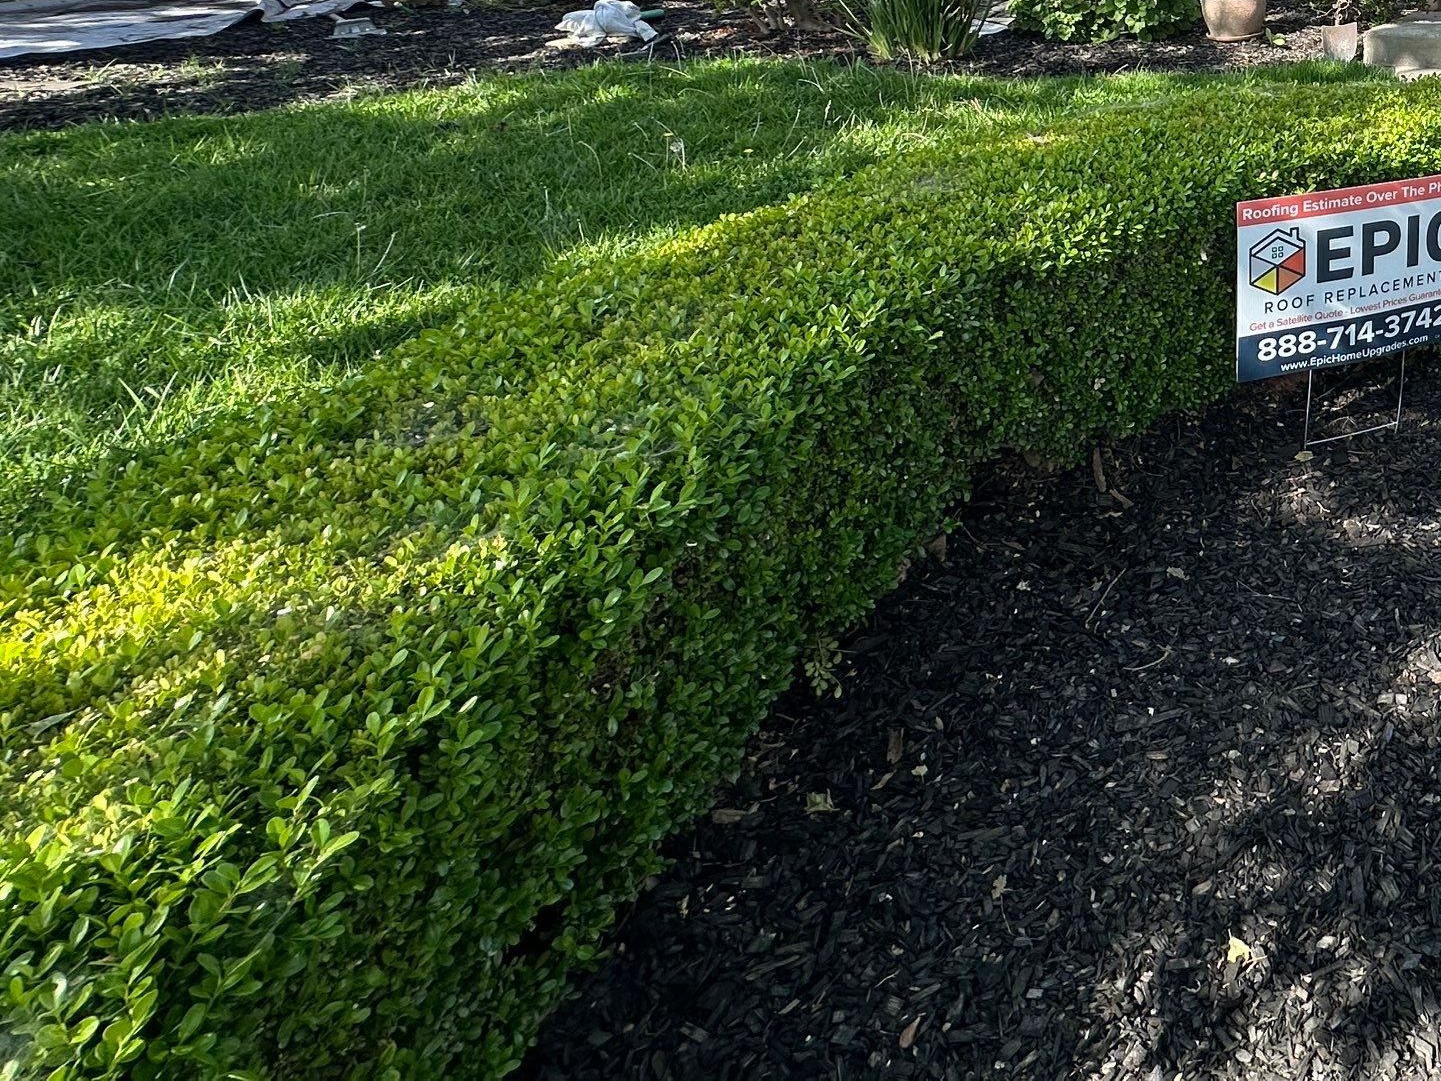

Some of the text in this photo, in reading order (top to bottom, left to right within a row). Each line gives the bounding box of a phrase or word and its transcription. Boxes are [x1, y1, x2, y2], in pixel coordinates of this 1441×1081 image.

[1242, 202, 1299, 220] Roofing
[1303, 195, 1362, 213] Estimate
[1366, 190, 1398, 204] Over
[1401, 185, 1425, 199] The
[1249, 320, 1267, 332] Get
[1276, 313, 1313, 327] Satellite
[1314, 308, 1343, 320] Quote
[1350, 302, 1381, 315] Lowest
[1382, 296, 1407, 309] Prices
[1264, 294, 1315, 314] ROOF
[1280, 333, 1429, 372] www.EpicHomeUpgrades.com
